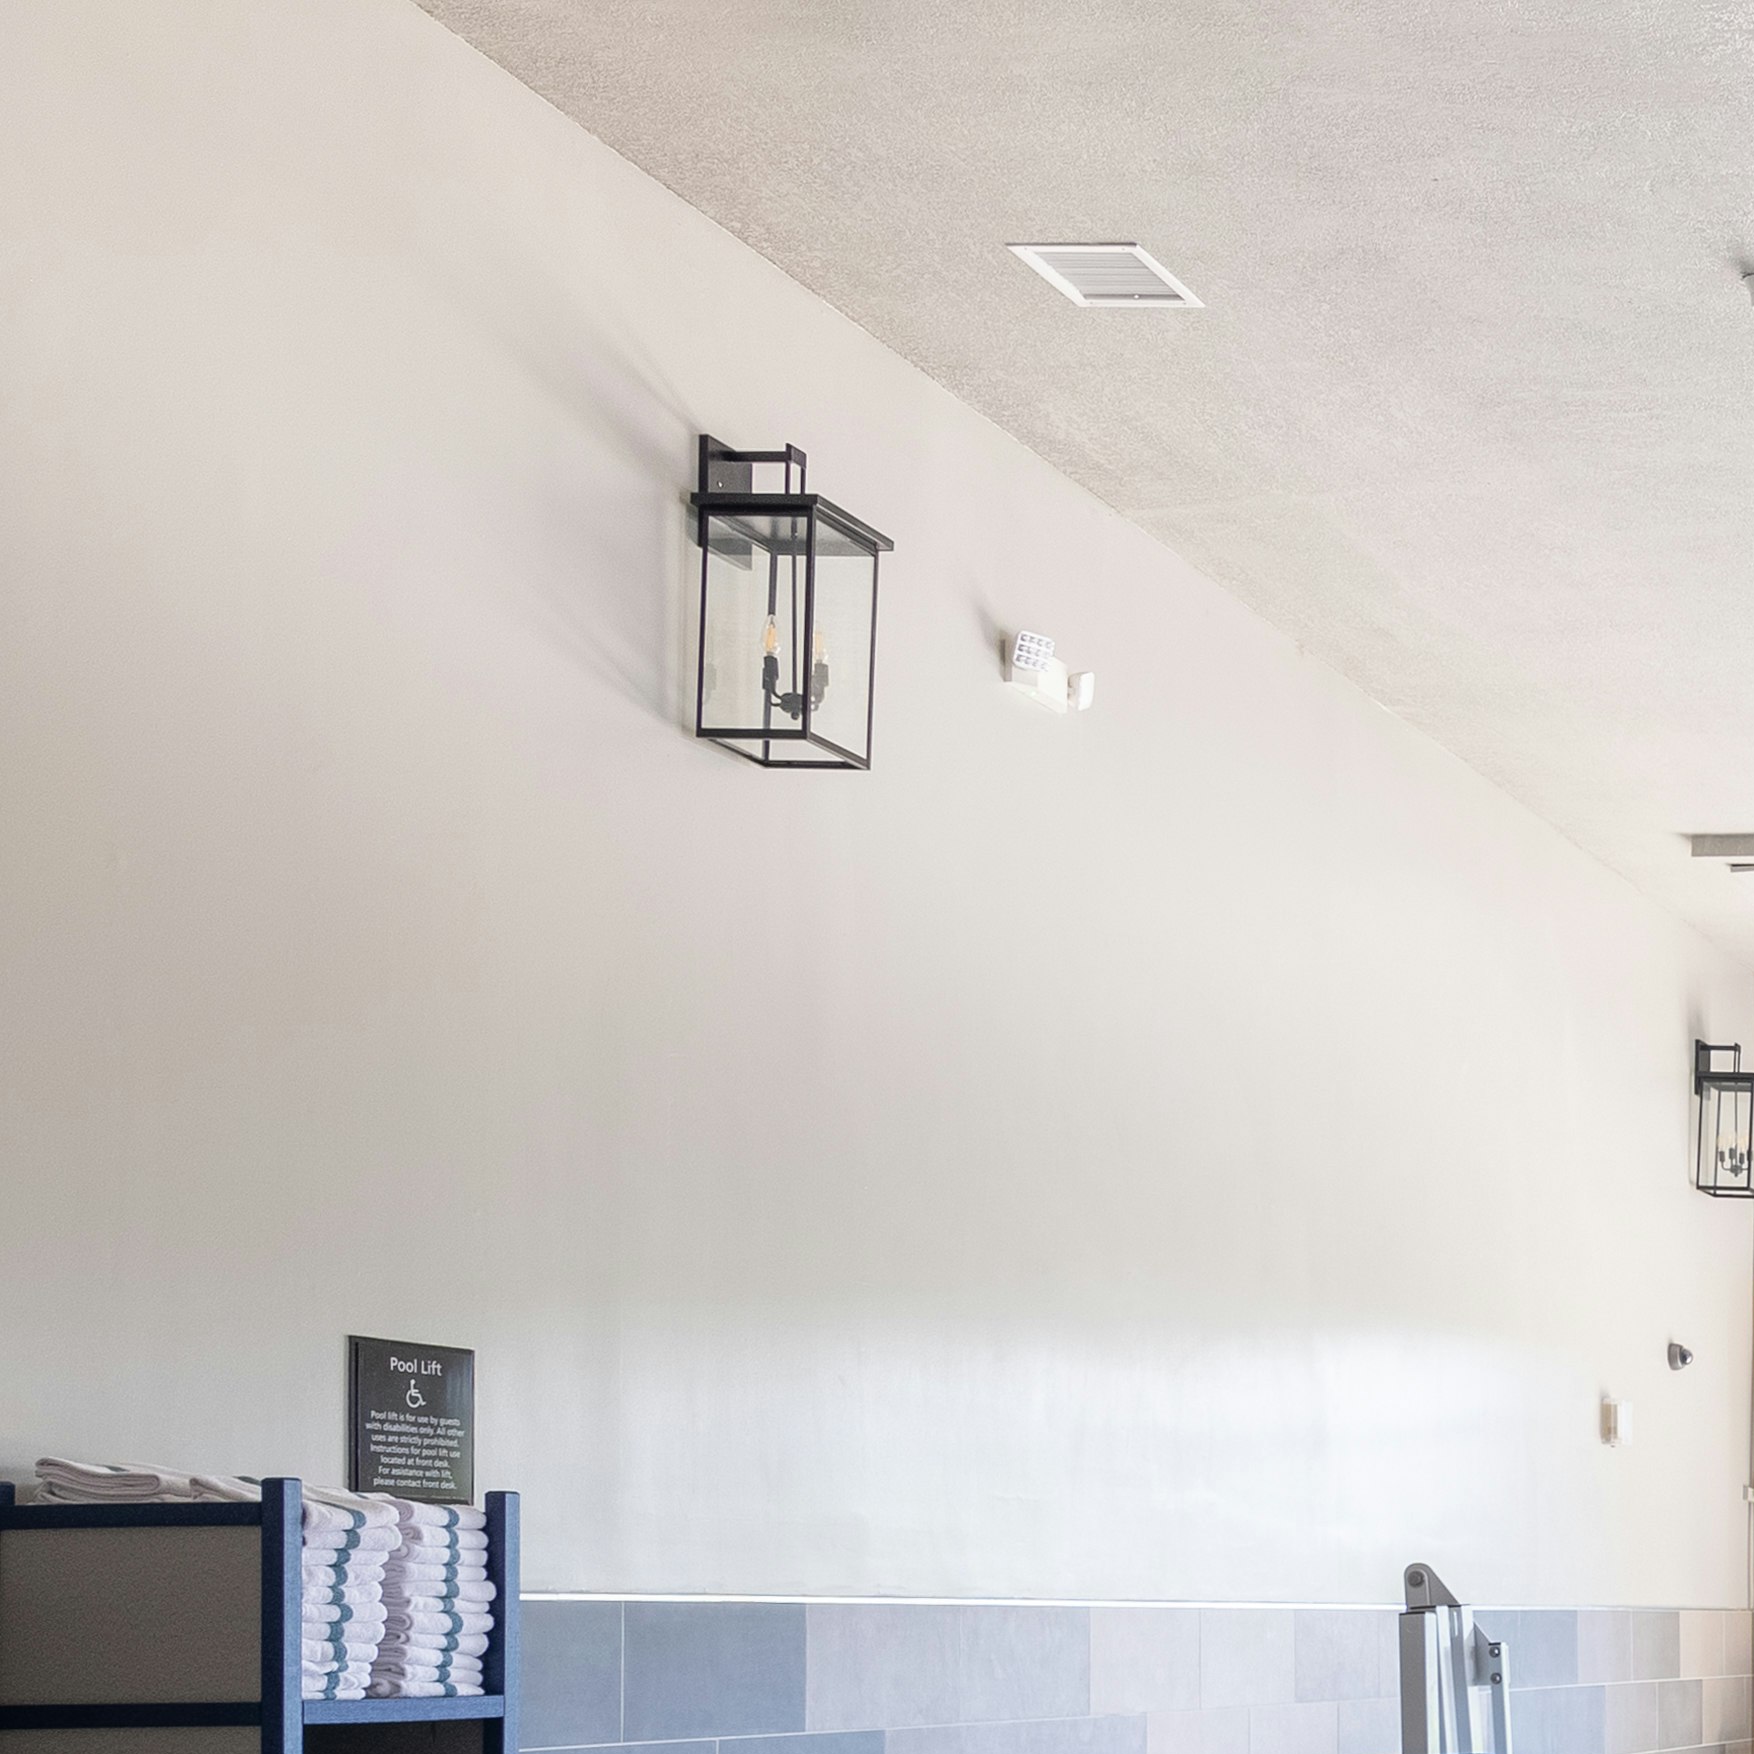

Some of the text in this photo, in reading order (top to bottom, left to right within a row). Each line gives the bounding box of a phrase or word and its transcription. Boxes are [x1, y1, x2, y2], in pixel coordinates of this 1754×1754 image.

[390, 1357, 442, 1376] Pool Lift
[370, 1410, 386, 1419] Pool
[388, 1412, 398, 1420] lift
[406, 1413, 416, 1422] for
[430, 1416, 438, 1426] by
[440, 1418, 460, 1426] guests
[365, 1421, 381, 1430] with
[383, 1422, 418, 1433] disabilities
[436, 1427, 446, 1435] All
[447, 1429, 464, 1437] other
[372, 1434, 386, 1442] uses
[400, 1435, 421, 1446] strictly
[370, 1444, 410, 1454] Instructions
[411, 1446, 421, 1455] for
[422, 1448, 437, 1457] pool
[439, 1448, 448, 1457] lift
[380, 1455, 406, 1465] located
[416, 1457, 432, 1467] front
[379, 1466, 390, 1474] For
[391, 1467, 423, 1477] assistance
[425, 1470, 440, 1478] with
[373, 1477, 395, 1486] please
[423, 1479, 439, 1488] front
